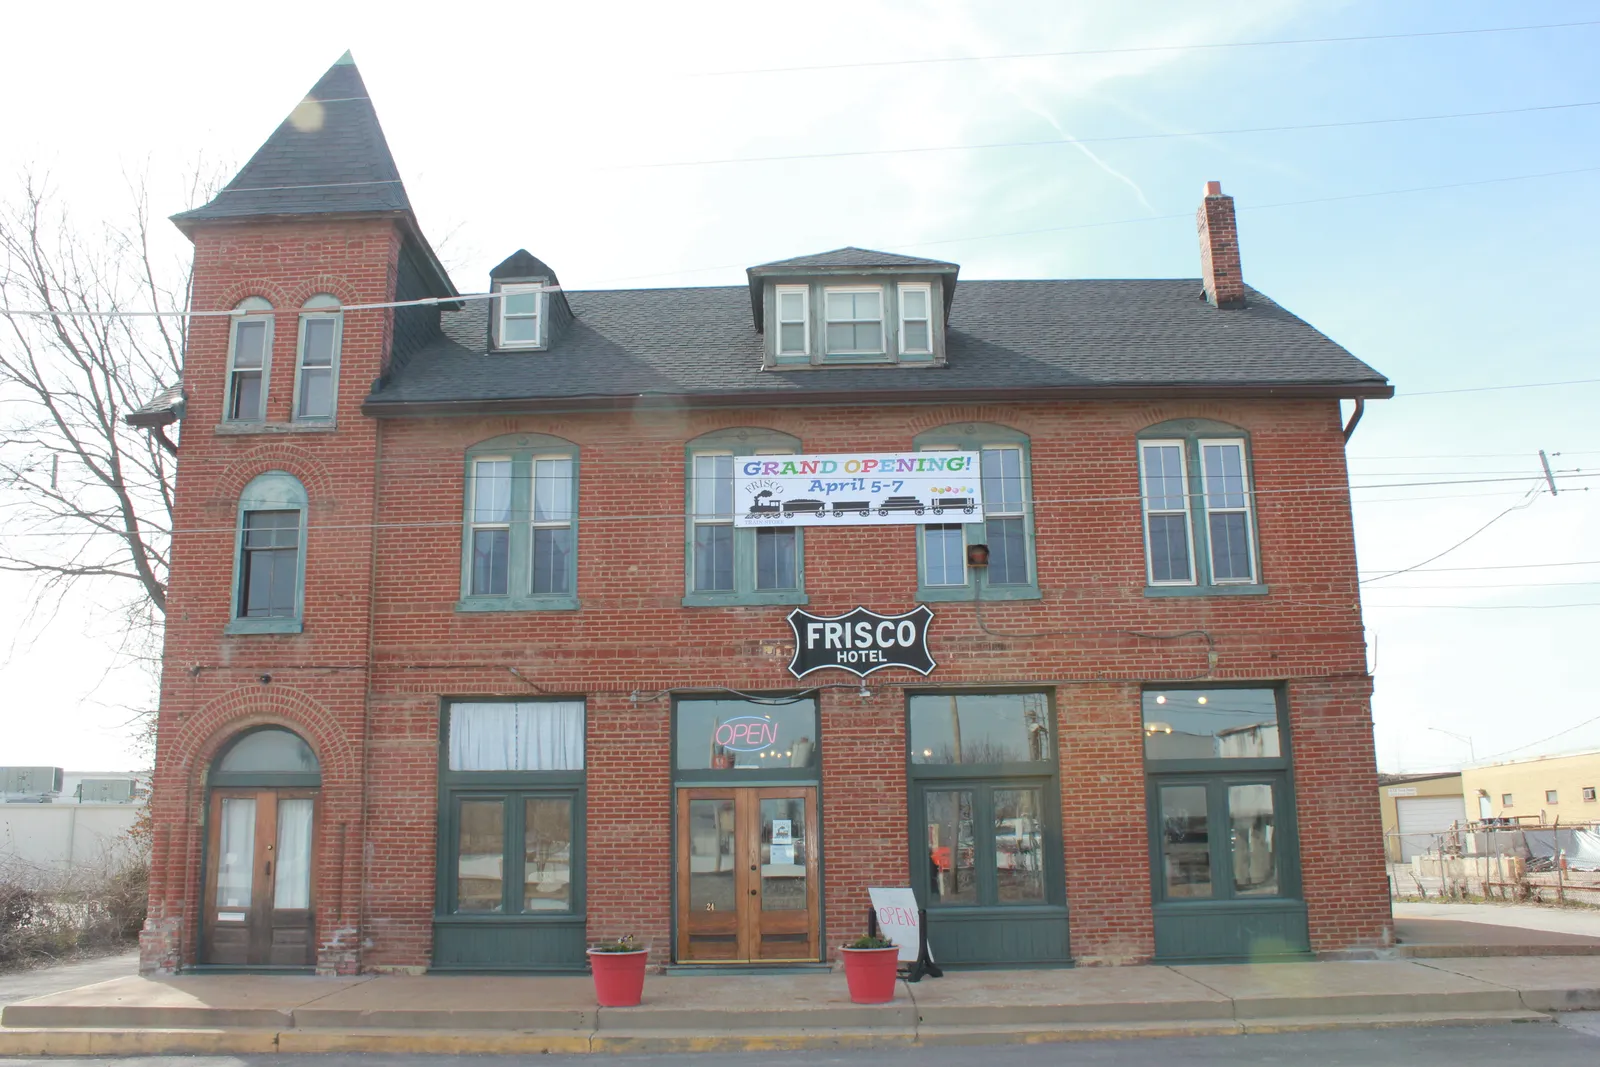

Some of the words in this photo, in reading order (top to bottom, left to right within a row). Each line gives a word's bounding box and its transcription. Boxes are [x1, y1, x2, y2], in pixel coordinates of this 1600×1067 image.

[743, 460, 838, 476] GRAND
[844, 456, 972, 474] OPENING!
[745, 479, 784, 494] FRISCO
[808, 478, 866, 495] April
[871, 480, 904, 493] 5-7
[807, 620, 916, 650] FRISCO
[837, 650, 887, 663] HOTEL
[715, 723, 778, 745] OPEN
[880, 906, 917, 927] OPEN
